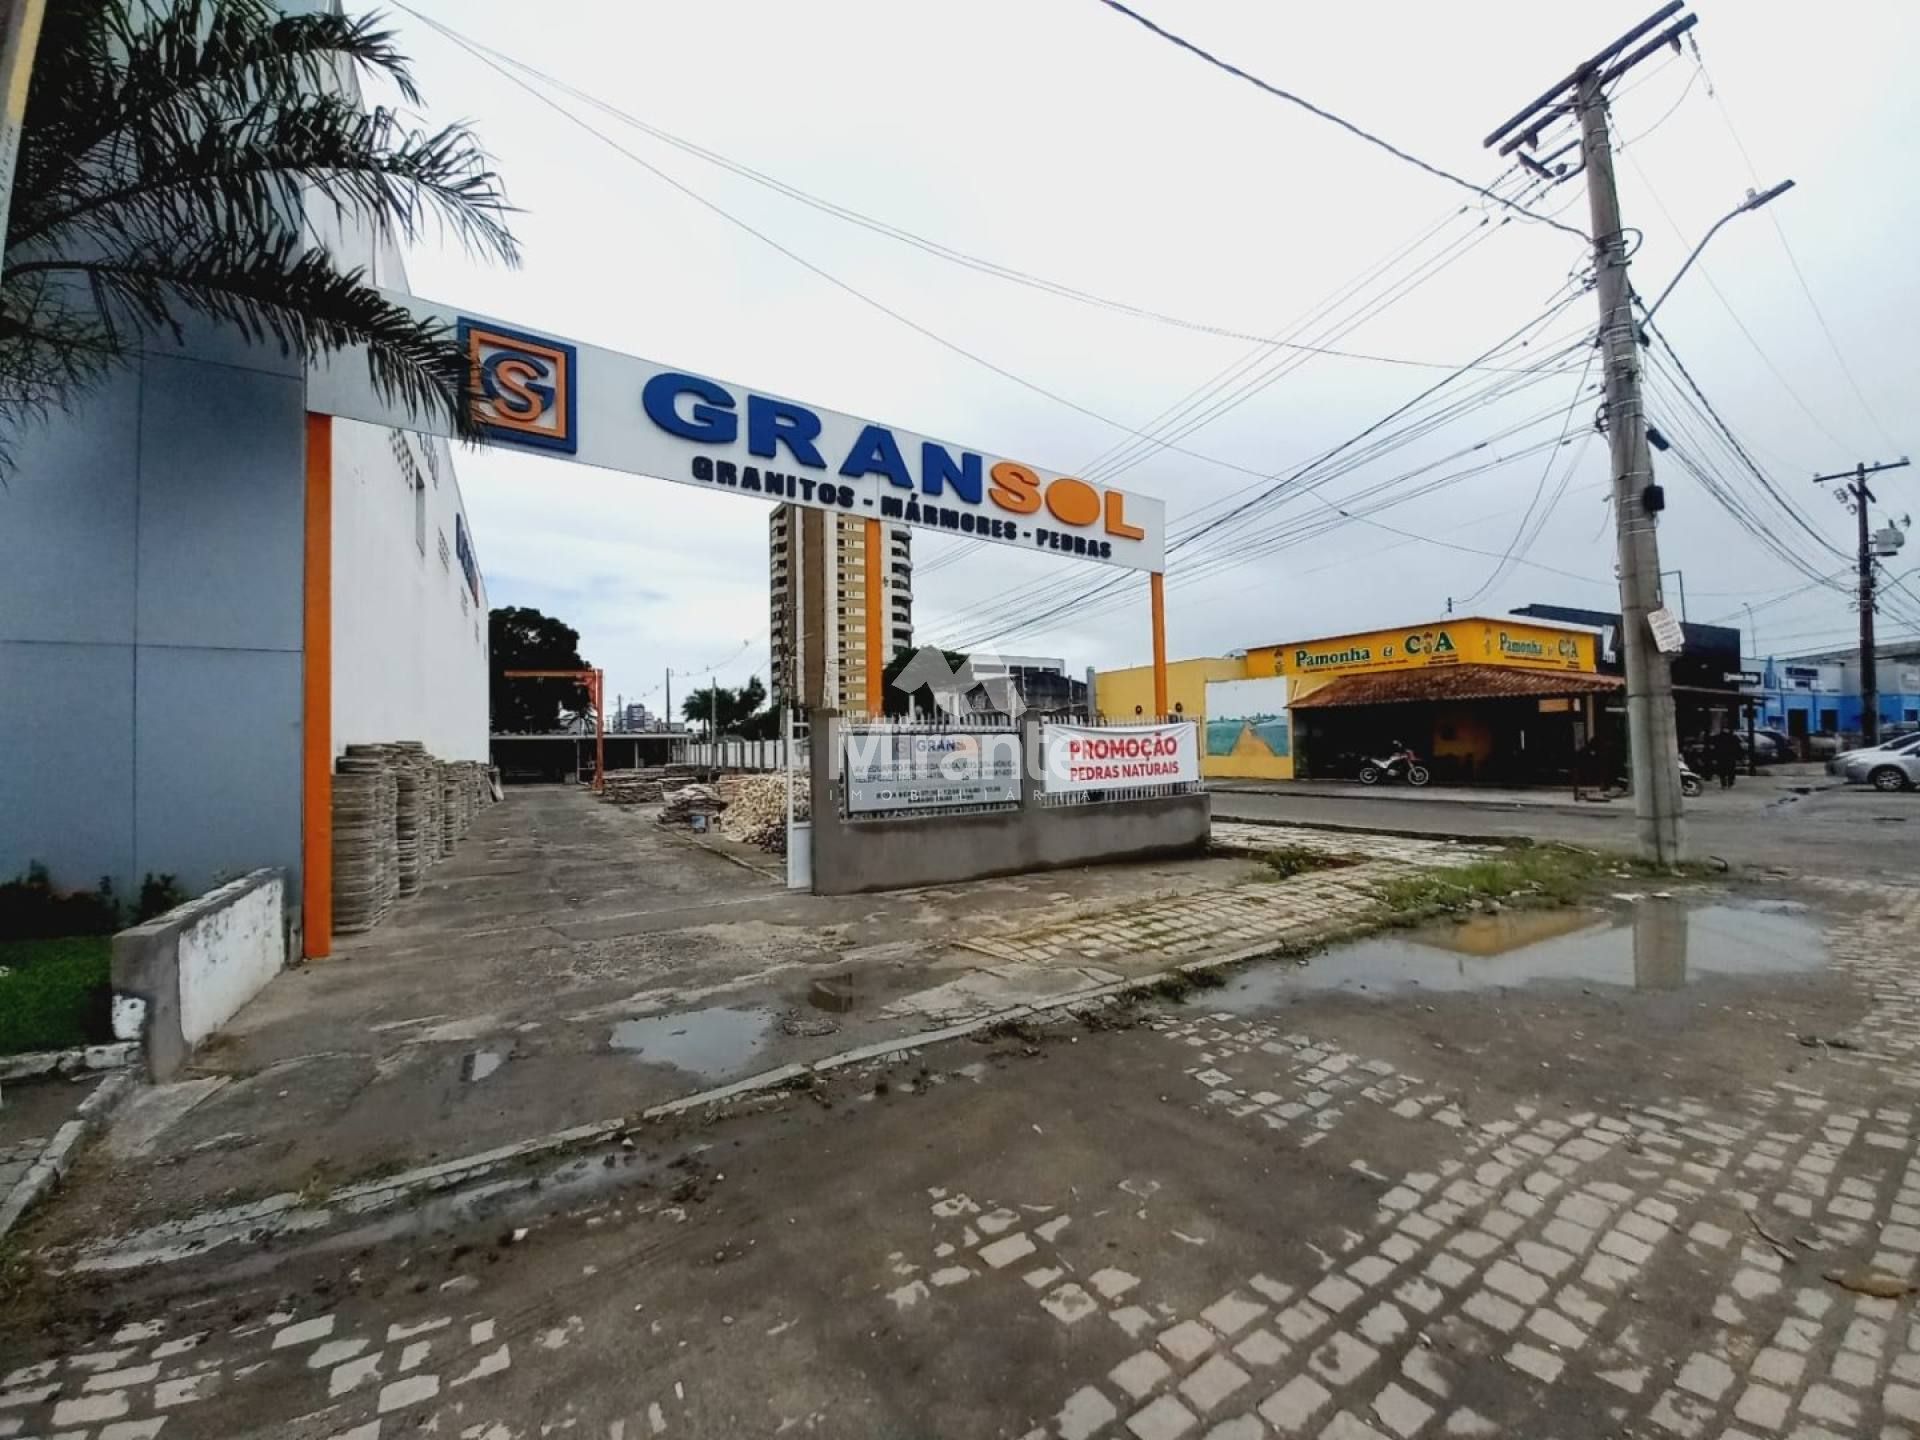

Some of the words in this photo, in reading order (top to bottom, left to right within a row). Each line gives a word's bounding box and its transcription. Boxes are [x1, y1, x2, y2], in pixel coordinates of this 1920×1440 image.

[642, 371, 1145, 541] GRANSOL
[691, 455, 855, 509] GRANITOS
[880, 492, 1018, 540] MÁRMORES
[1036, 527, 1113, 559] PEDRAS
[1499, 631, 1543, 654] Pamonha
[1295, 647, 1370, 668] Pamonha
[1069, 730, 1178, 761] PROMOÇÃO
[1070, 765, 1120, 781] PEDRAS
[1122, 761, 1180, 778] NATURAIS
